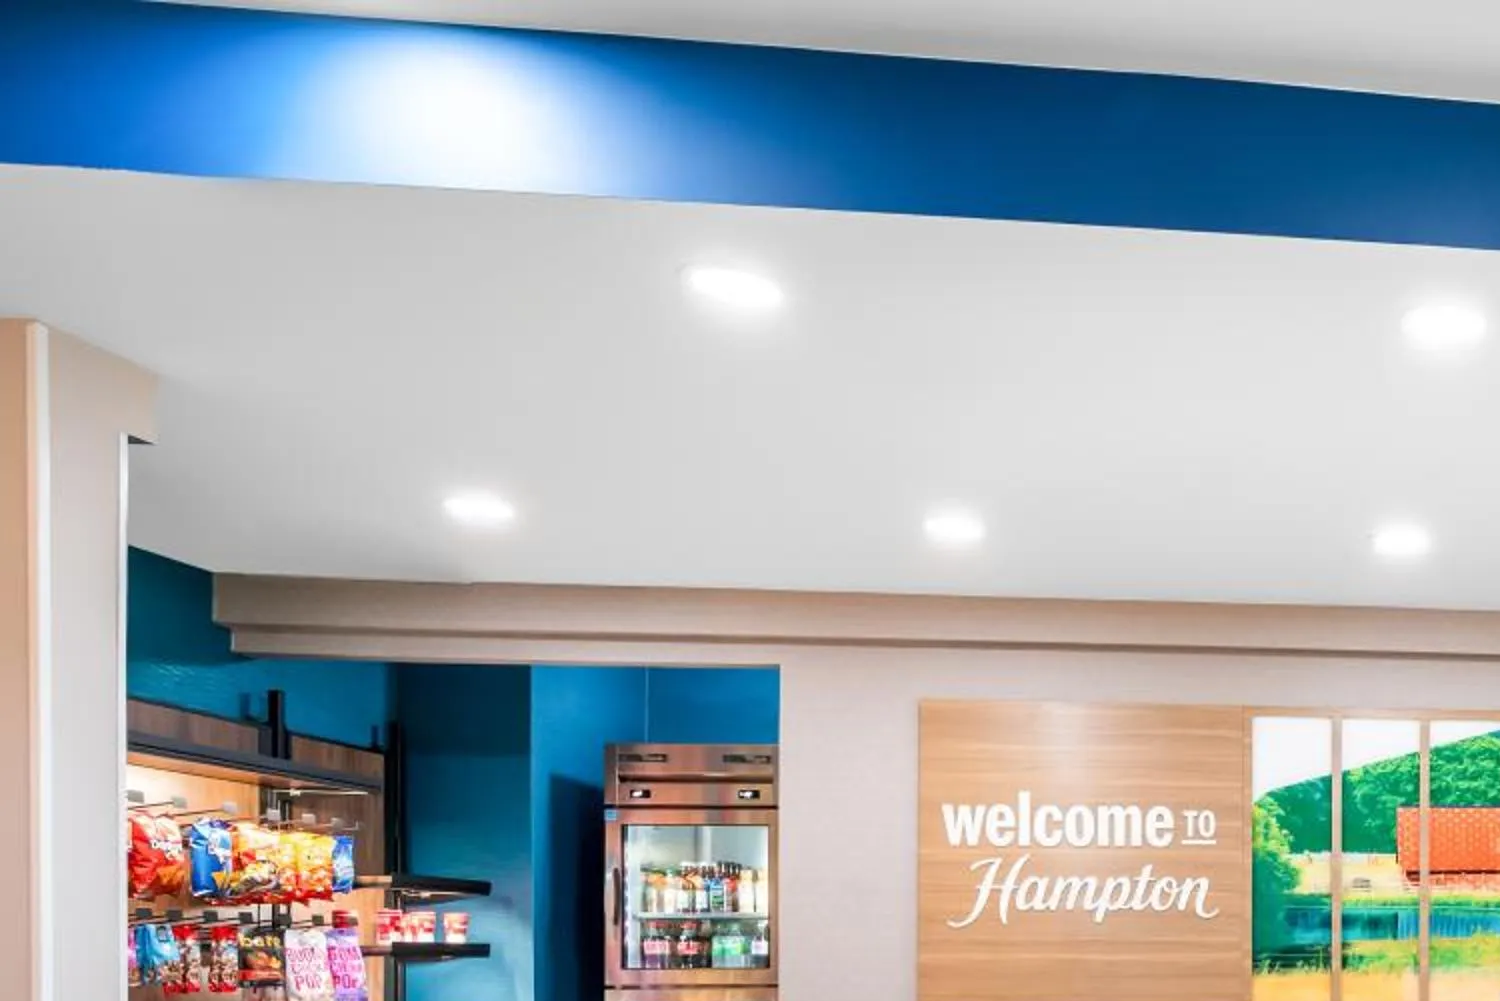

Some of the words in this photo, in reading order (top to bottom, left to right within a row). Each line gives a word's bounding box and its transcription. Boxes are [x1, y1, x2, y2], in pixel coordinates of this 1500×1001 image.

[942, 790, 1175, 847] welcome
[1181, 810, 1217, 838] TO
[947, 854, 1220, 928] Hampton
